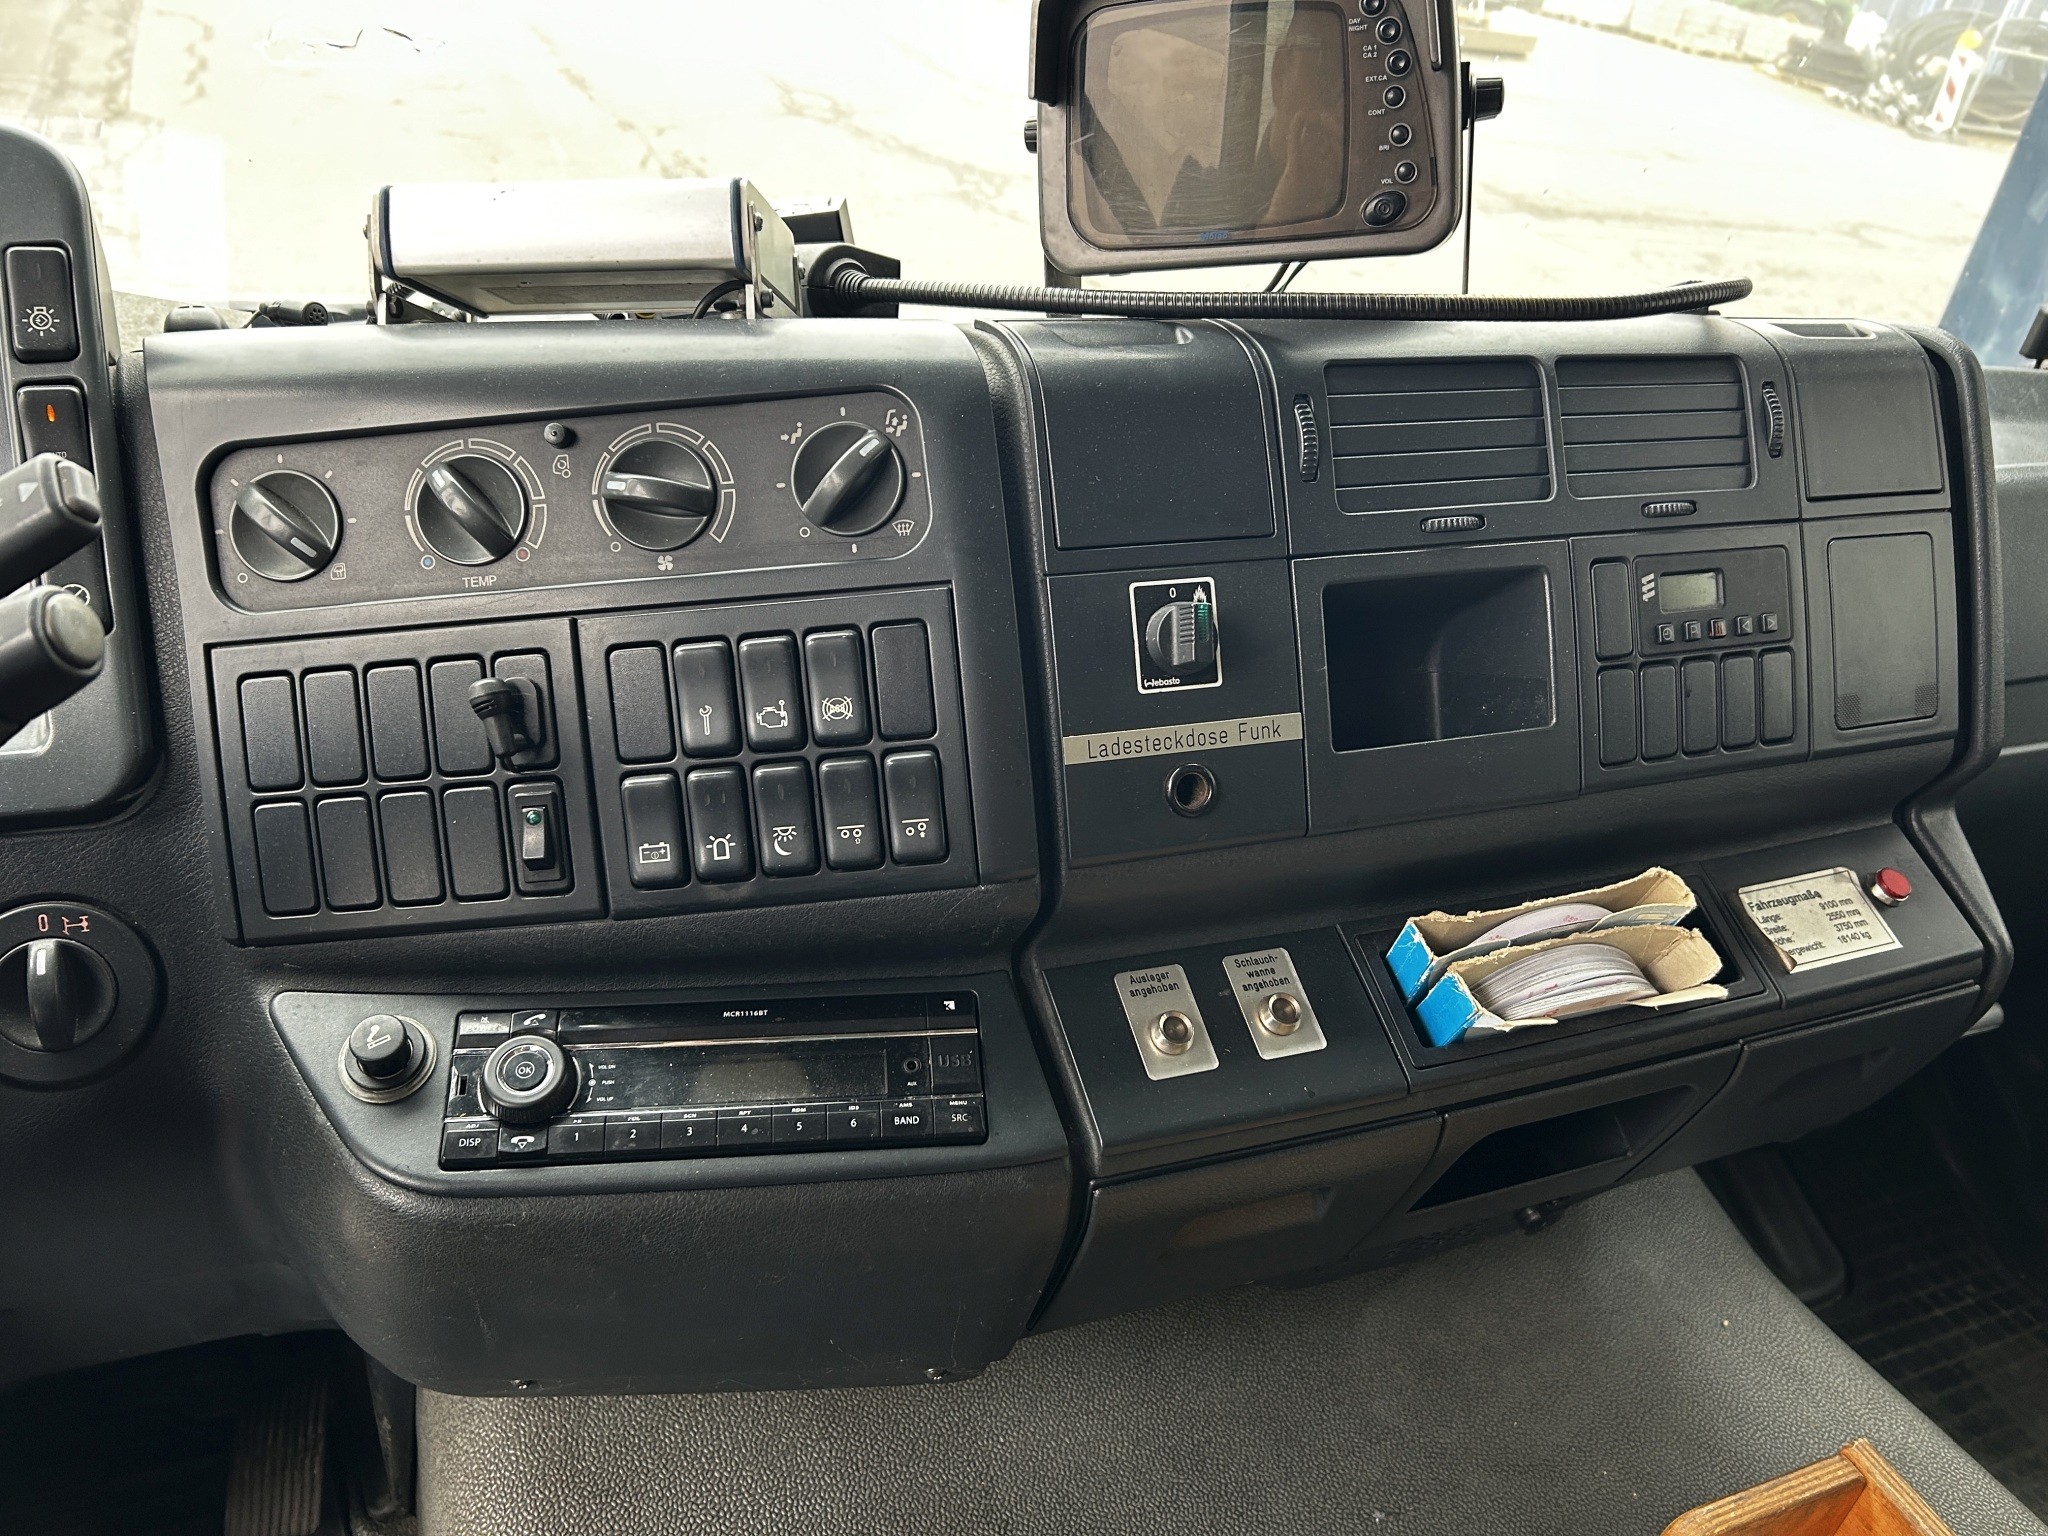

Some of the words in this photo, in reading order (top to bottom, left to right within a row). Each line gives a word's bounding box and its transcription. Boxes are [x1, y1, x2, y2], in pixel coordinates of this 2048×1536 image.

[1348, 24, 1368, 32] NIGHT
[461, 574, 497, 588] TEMP
[1144, 676, 1181, 688] Webasto
[1087, 728, 1229, 760] Ladesteckdose
[1238, 720, 1282, 742] Funk
[1747, 889, 1822, 913] Fahrzeugmaße
[1819, 899, 1839, 911] 9100
[1838, 898, 1854, 907] mm
[1826, 910, 1846, 921] 2550
[1833, 922, 1853, 933] 3750
[1853, 920, 1869, 929] mm
[1837, 933, 1861, 945] 18140
[1861, 931, 1872, 940] kg
[1234, 953, 1278, 968] Schlauch-
[1129, 970, 1171, 985] Ausleger
[1246, 966, 1276, 979] wanne
[1129, 981, 1180, 998] angehoben
[1242, 976, 1291, 992] angehoben
[723, 1009, 769, 1018] MCR1116BT
[938, 1053, 972, 1068] USB
[518, 1066, 532, 1074] OK
[850, 1118, 857, 1128] 6
[894, 1115, 920, 1125] BAND
[951, 1113, 969, 1122] SRC
[686, 1126, 693, 1136] 3
[740, 1123, 748, 1133] 4
[796, 1121, 803, 1131] 5
[574, 1132, 579, 1141] 1
[629, 1129, 637, 1139] 2
[458, 1137, 482, 1147] DISP
